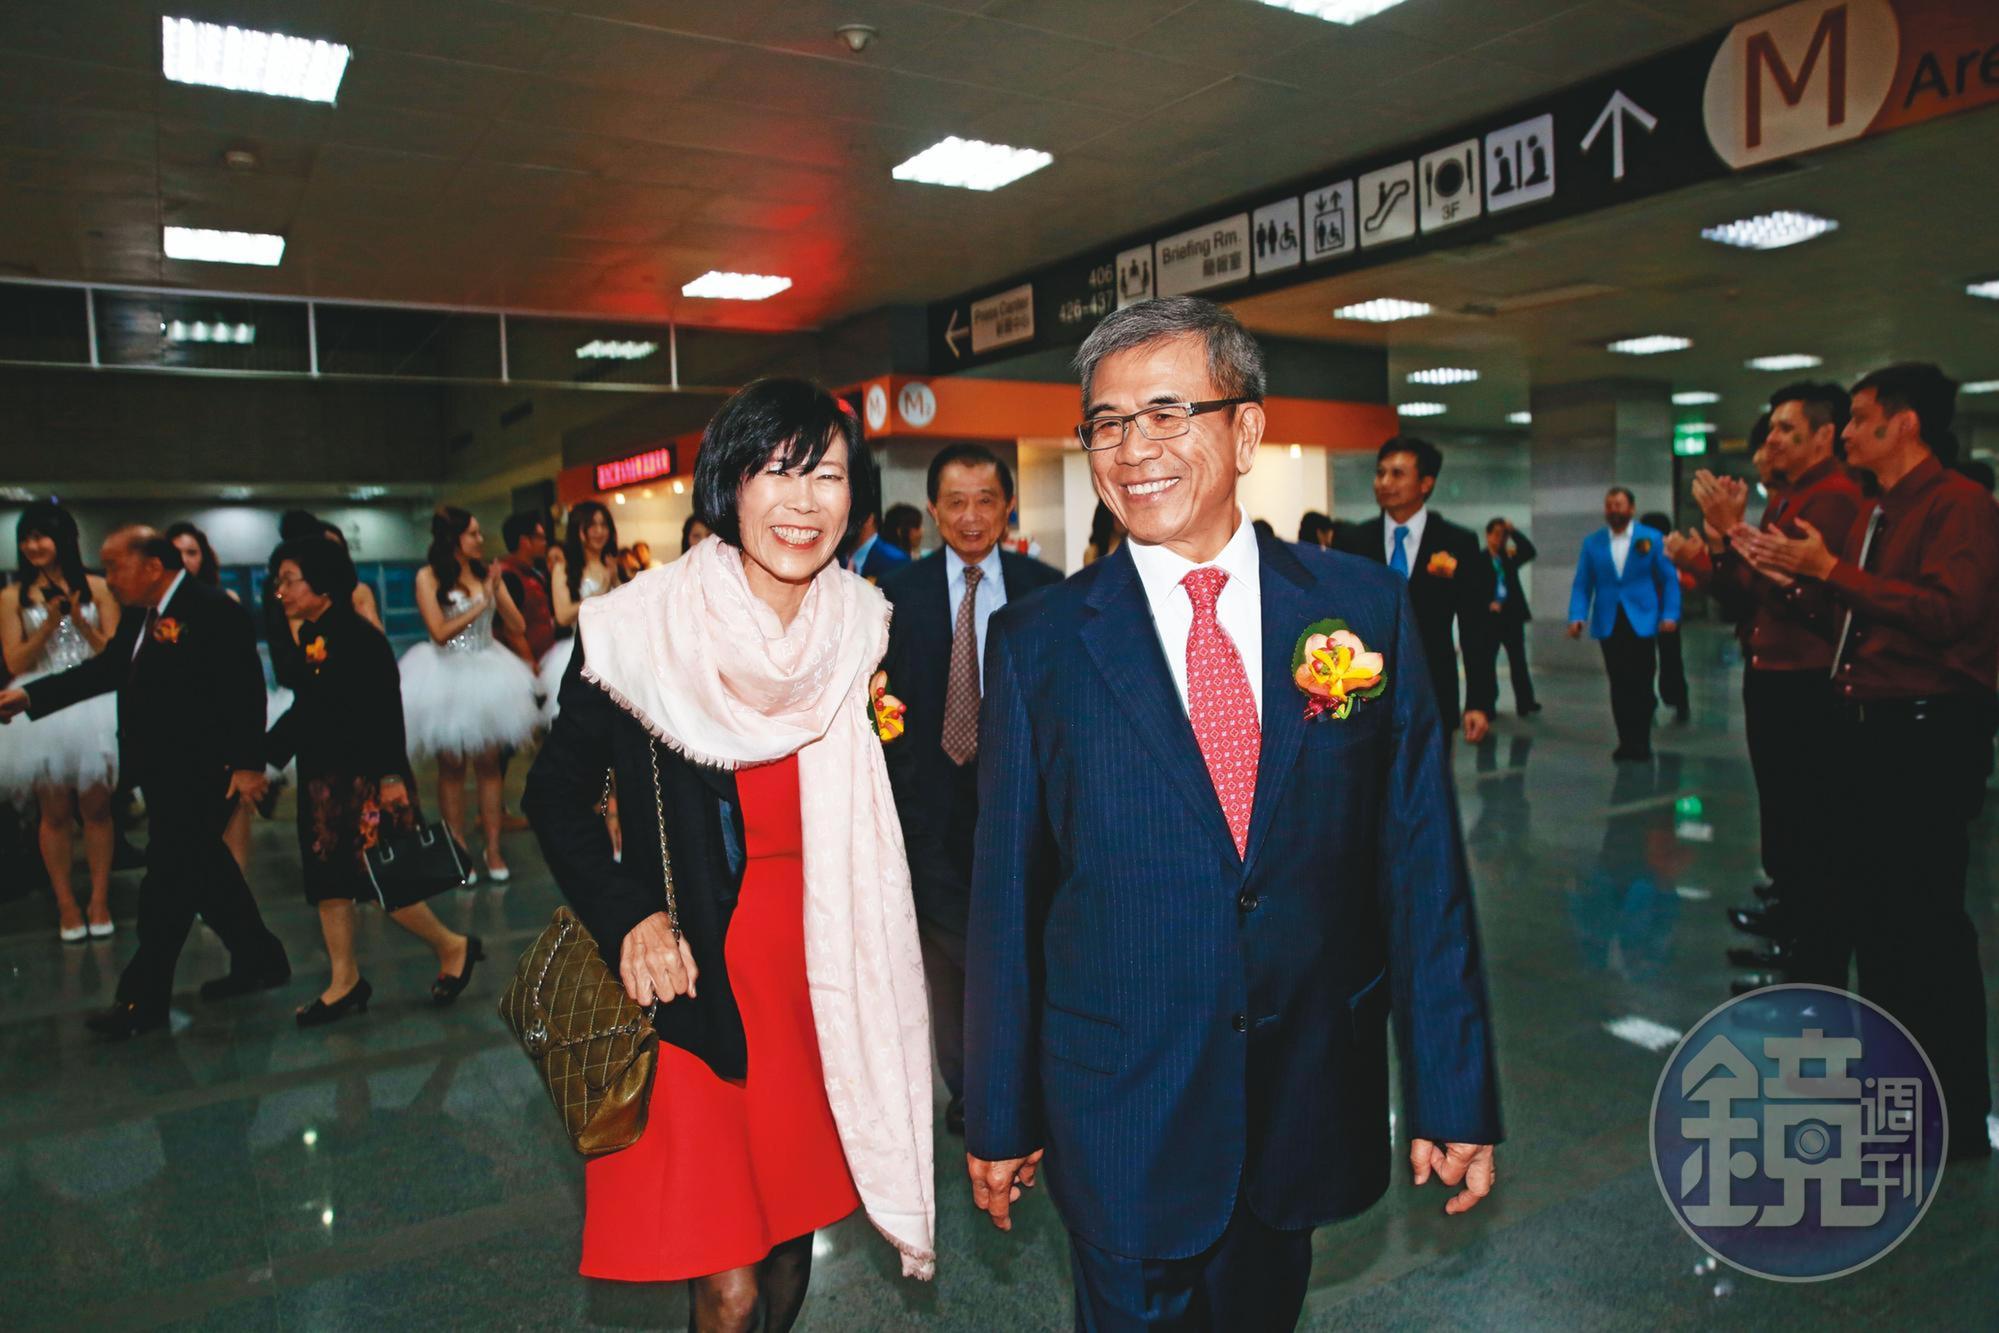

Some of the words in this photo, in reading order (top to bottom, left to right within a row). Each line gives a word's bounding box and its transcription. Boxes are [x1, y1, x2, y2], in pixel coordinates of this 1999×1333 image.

[1744, 3, 1848, 149] M
[1442, 200, 1460, 220] 3F
[1162, 239, 1211, 265] Briefing
[1213, 230, 1242, 249] Rm.
[1088, 263, 1114, 287] 406
[904, 390, 924, 418] M
